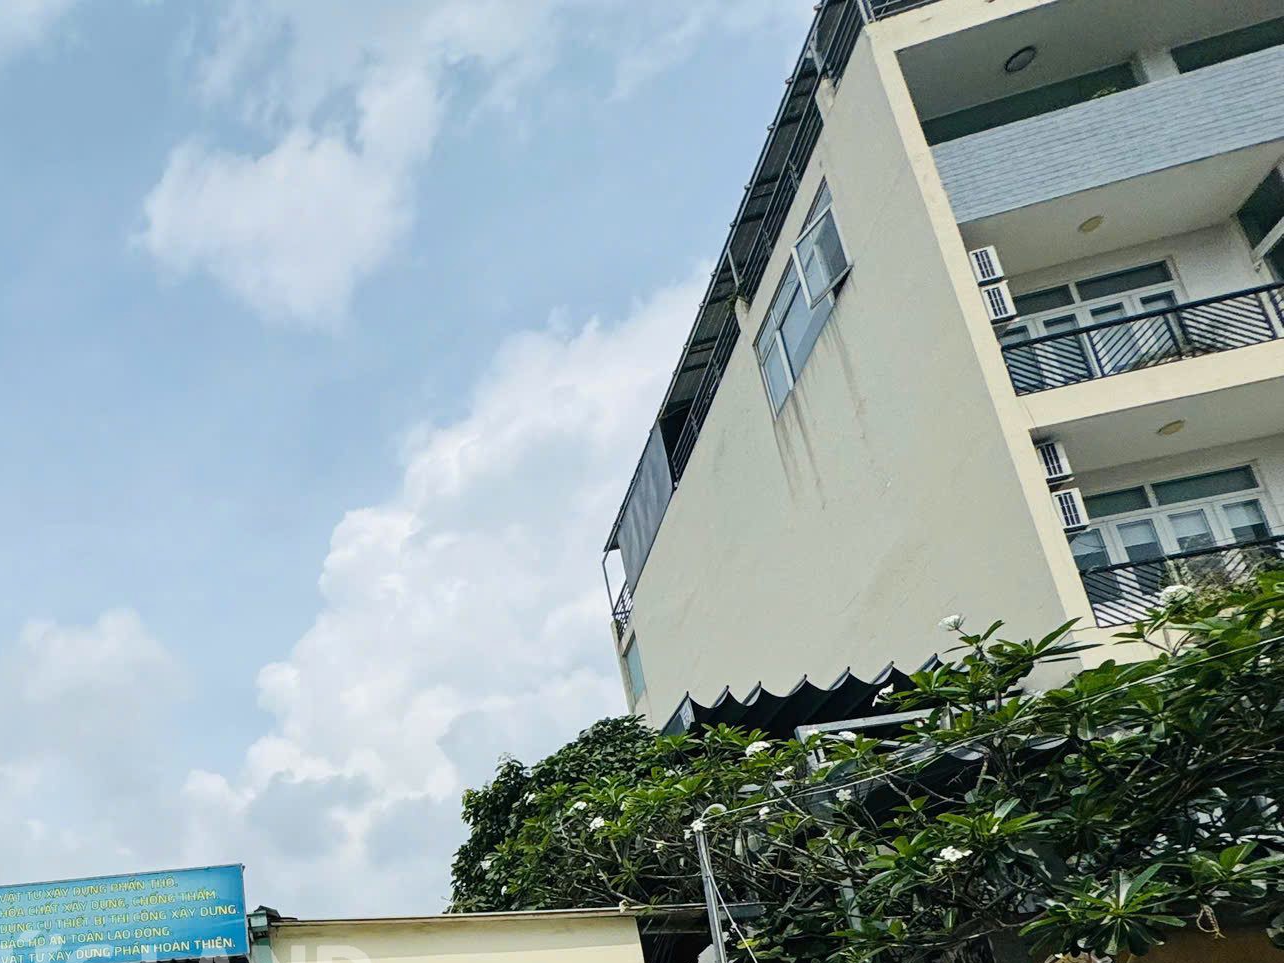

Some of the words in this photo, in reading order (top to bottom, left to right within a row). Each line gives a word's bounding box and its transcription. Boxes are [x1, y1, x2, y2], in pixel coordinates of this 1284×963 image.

[46, 886, 69, 898] XÂY
[73, 884, 108, 898] DỰNG
[63, 900, 87, 913] XÂY
[110, 913, 129, 924] THI
[132, 909, 167, 922] CÔNG
[171, 906, 197, 919] XÂY
[49, 936, 67, 946] AN
[71, 930, 104, 944] TOÀN
[107, 929, 131, 941] LAO
[48, 948, 73, 962] XÂY
[76, 946, 112, 960] DỰNG
[153, 940, 191, 953] HOÀN
